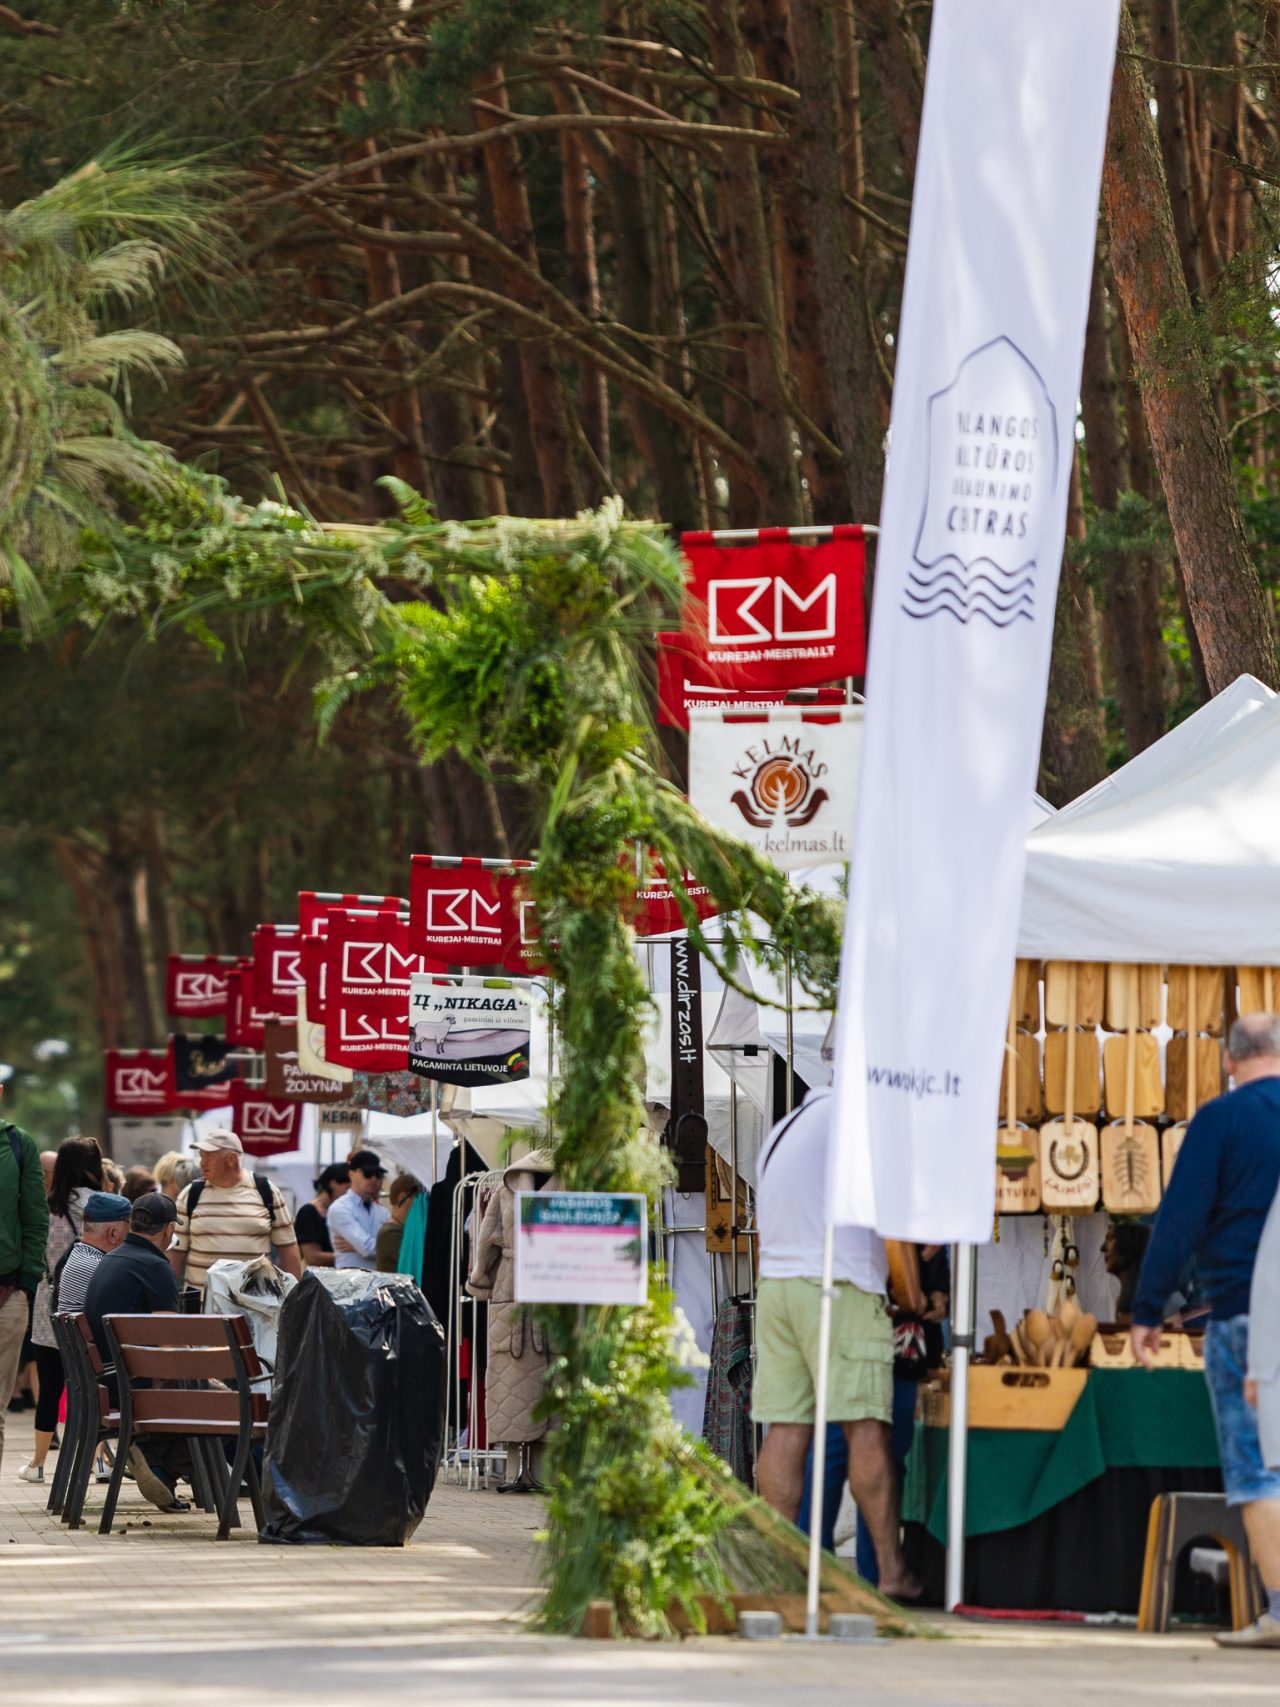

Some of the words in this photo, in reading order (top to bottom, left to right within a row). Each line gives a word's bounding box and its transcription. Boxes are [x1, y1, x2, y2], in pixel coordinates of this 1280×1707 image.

[683, 698, 784, 710] KUREJAI-MEISTRAI
[731, 734, 829, 781] KELMAS
[426, 935, 502, 946] KUREJAI-MEISTRAI
[674, 938, 698, 1064] ww.dirzas.lt
[412, 1058, 463, 1071] PAGAMINTA
[464, 1063, 509, 1073] LIETUVOJE
